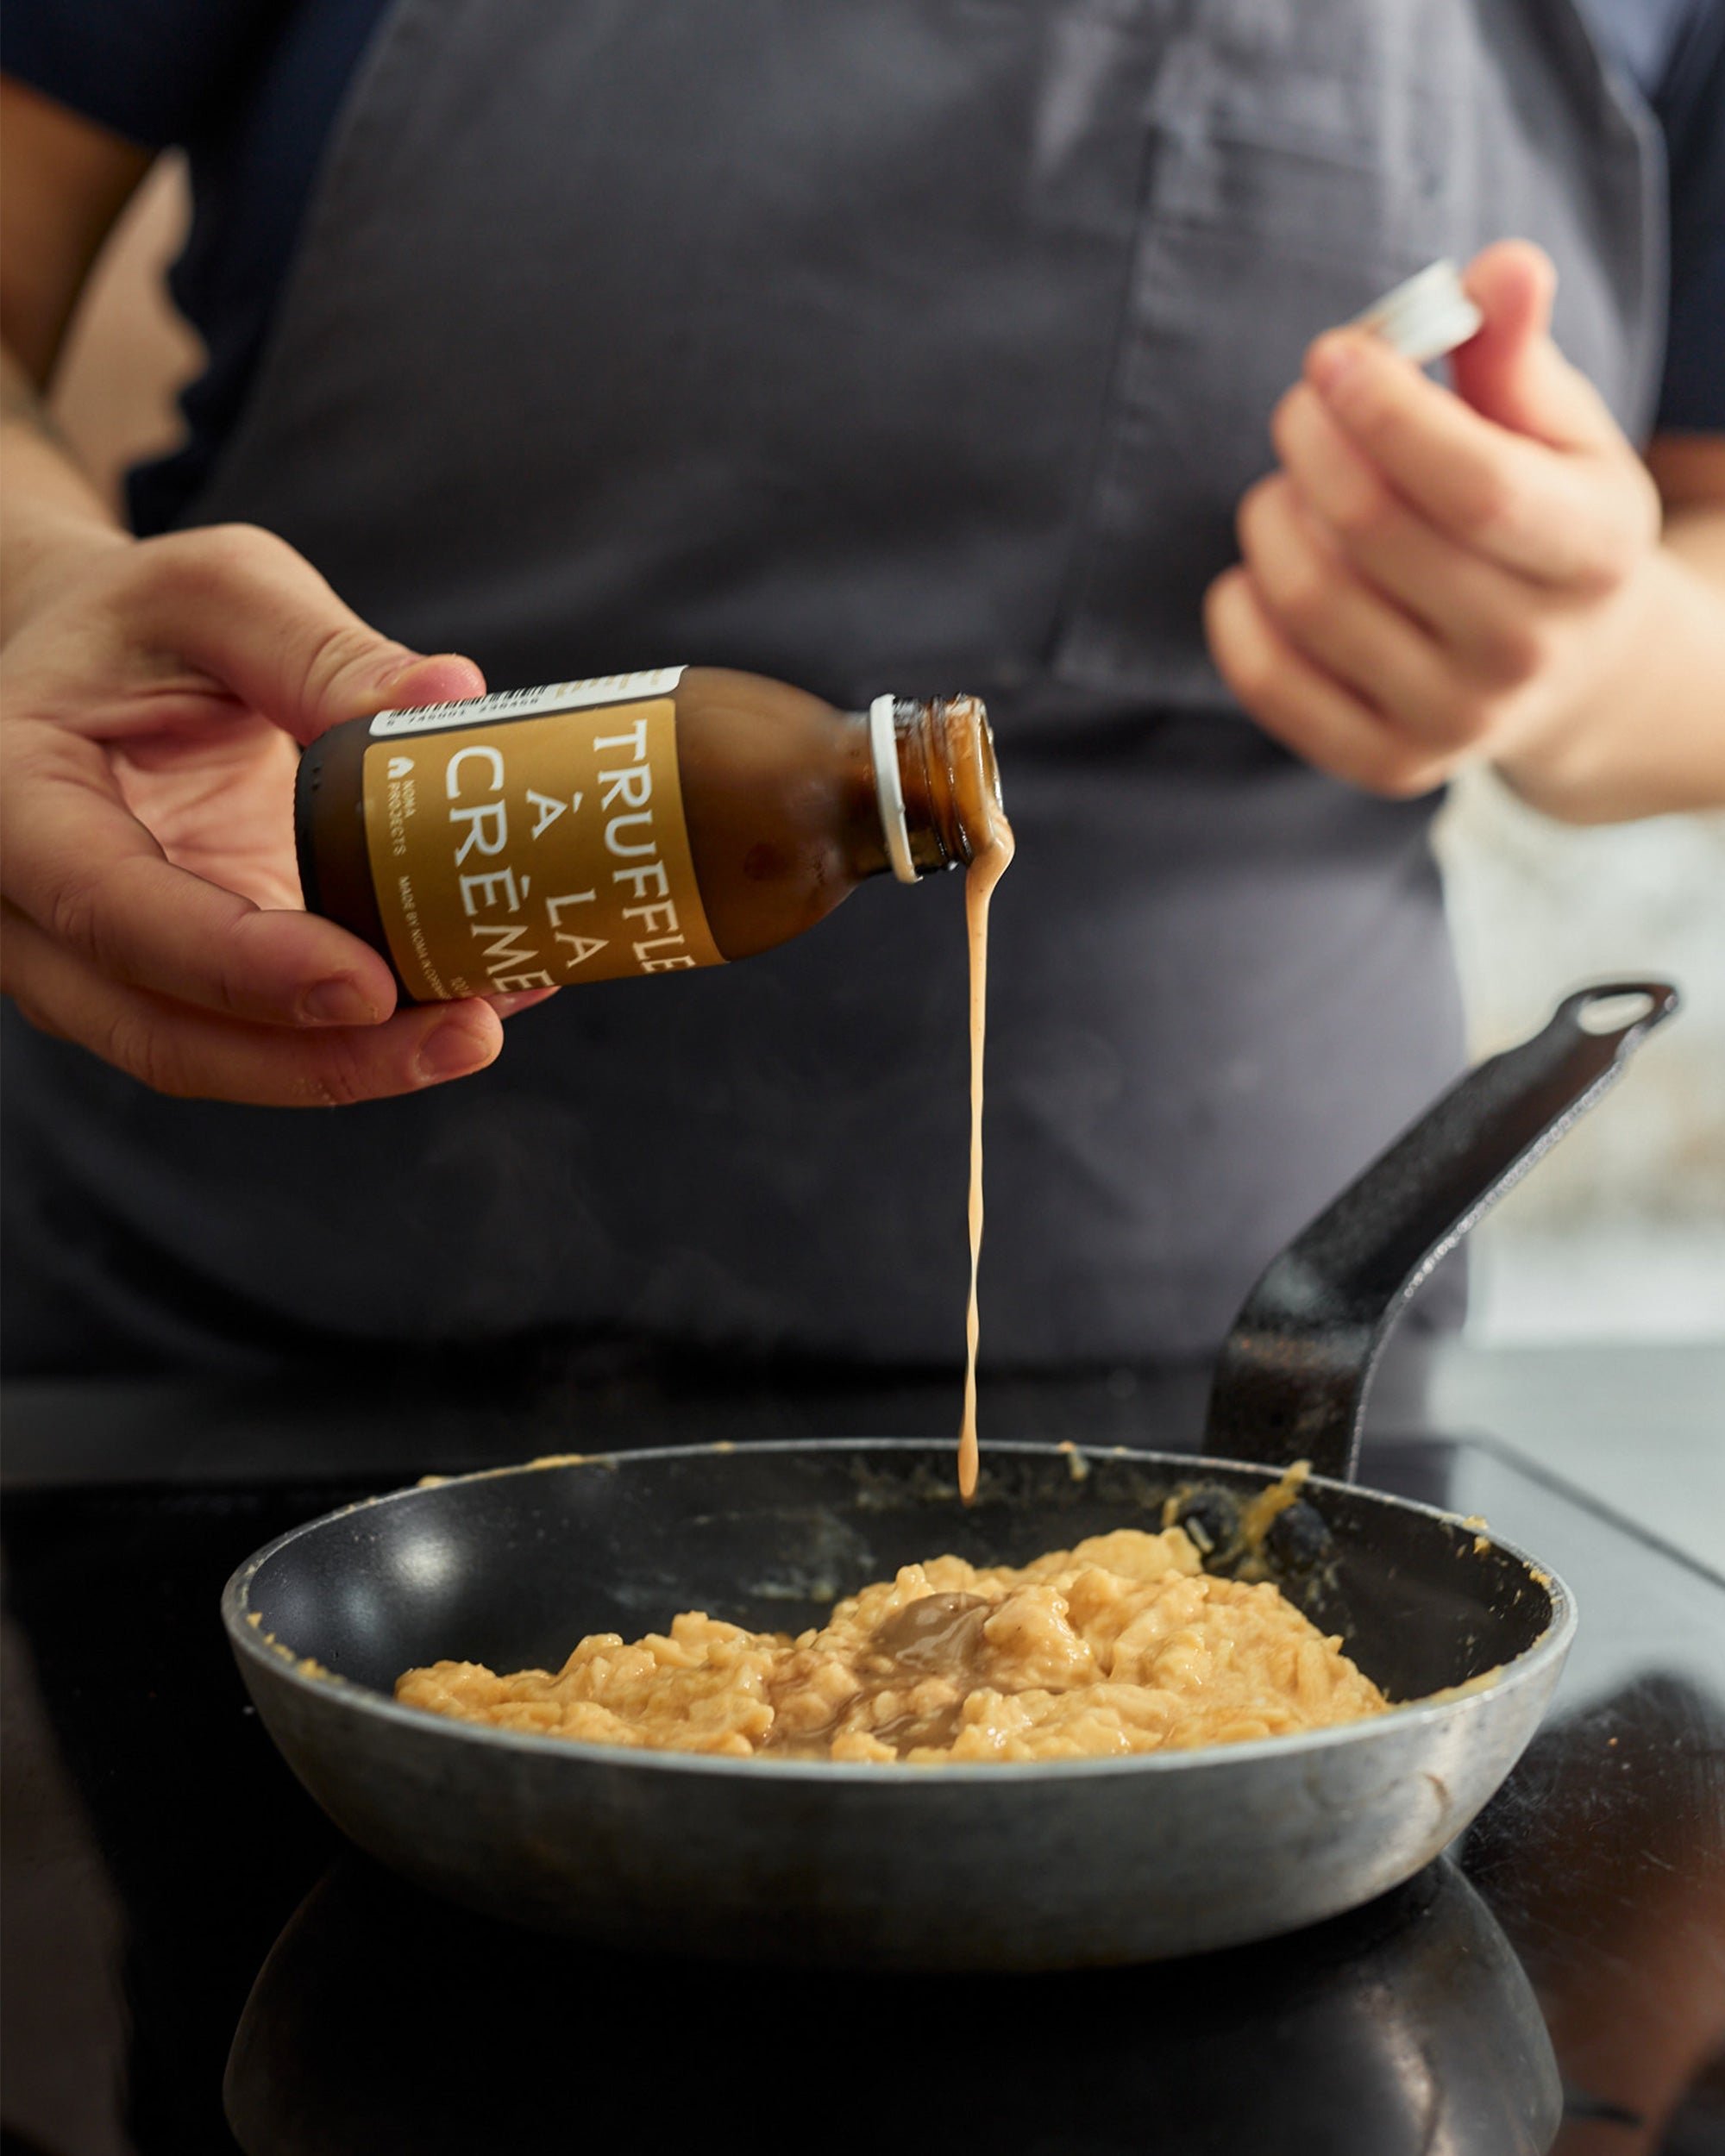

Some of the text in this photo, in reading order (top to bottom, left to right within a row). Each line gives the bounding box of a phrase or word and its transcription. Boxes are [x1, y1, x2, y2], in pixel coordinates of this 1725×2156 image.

[387, 781, 407, 856] PROJECTS
[401, 779, 417, 820] NOMA
[445, 745, 556, 993] CRÈME
[593, 718, 696, 974] TRUFFLE
[398, 874, 416, 911] MADE
[526, 788, 610, 968] À LA
[406, 911, 420, 927] BY
[411, 928, 430, 960] NOMA
